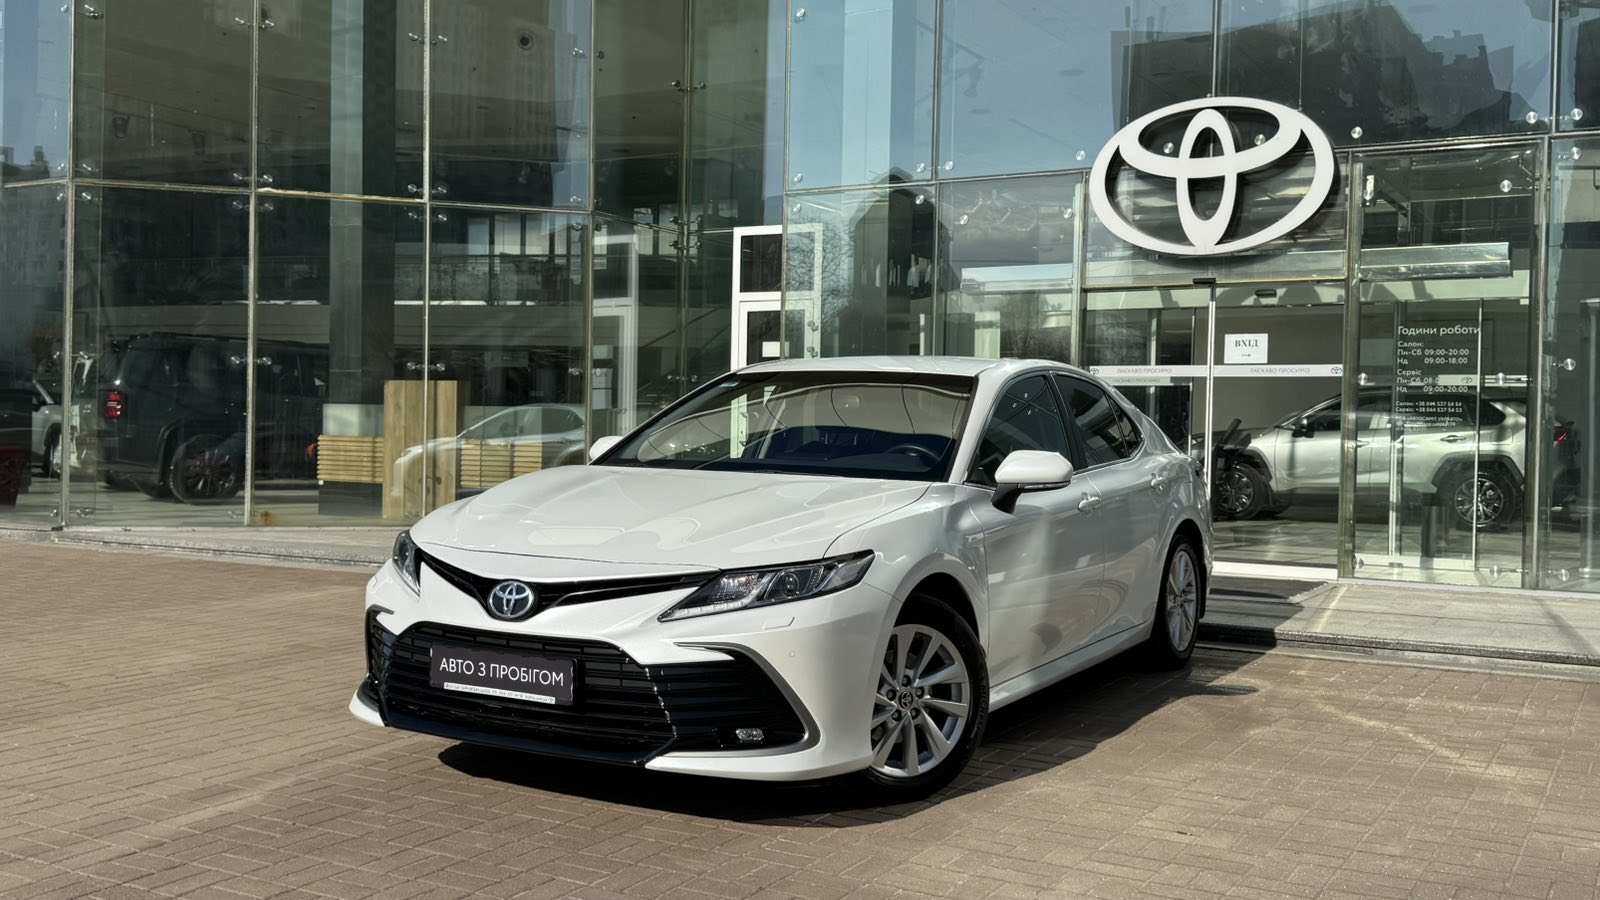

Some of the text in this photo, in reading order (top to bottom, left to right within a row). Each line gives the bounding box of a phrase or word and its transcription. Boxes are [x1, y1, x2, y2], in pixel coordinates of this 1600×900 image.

[1398, 325, 1480, 336] Години роботи
[1235, 339, 1259, 348] ВХІД
[1397, 357, 1409, 365] Нд
[440, 657, 564, 687] АВТО З ПРОБІГОМ
